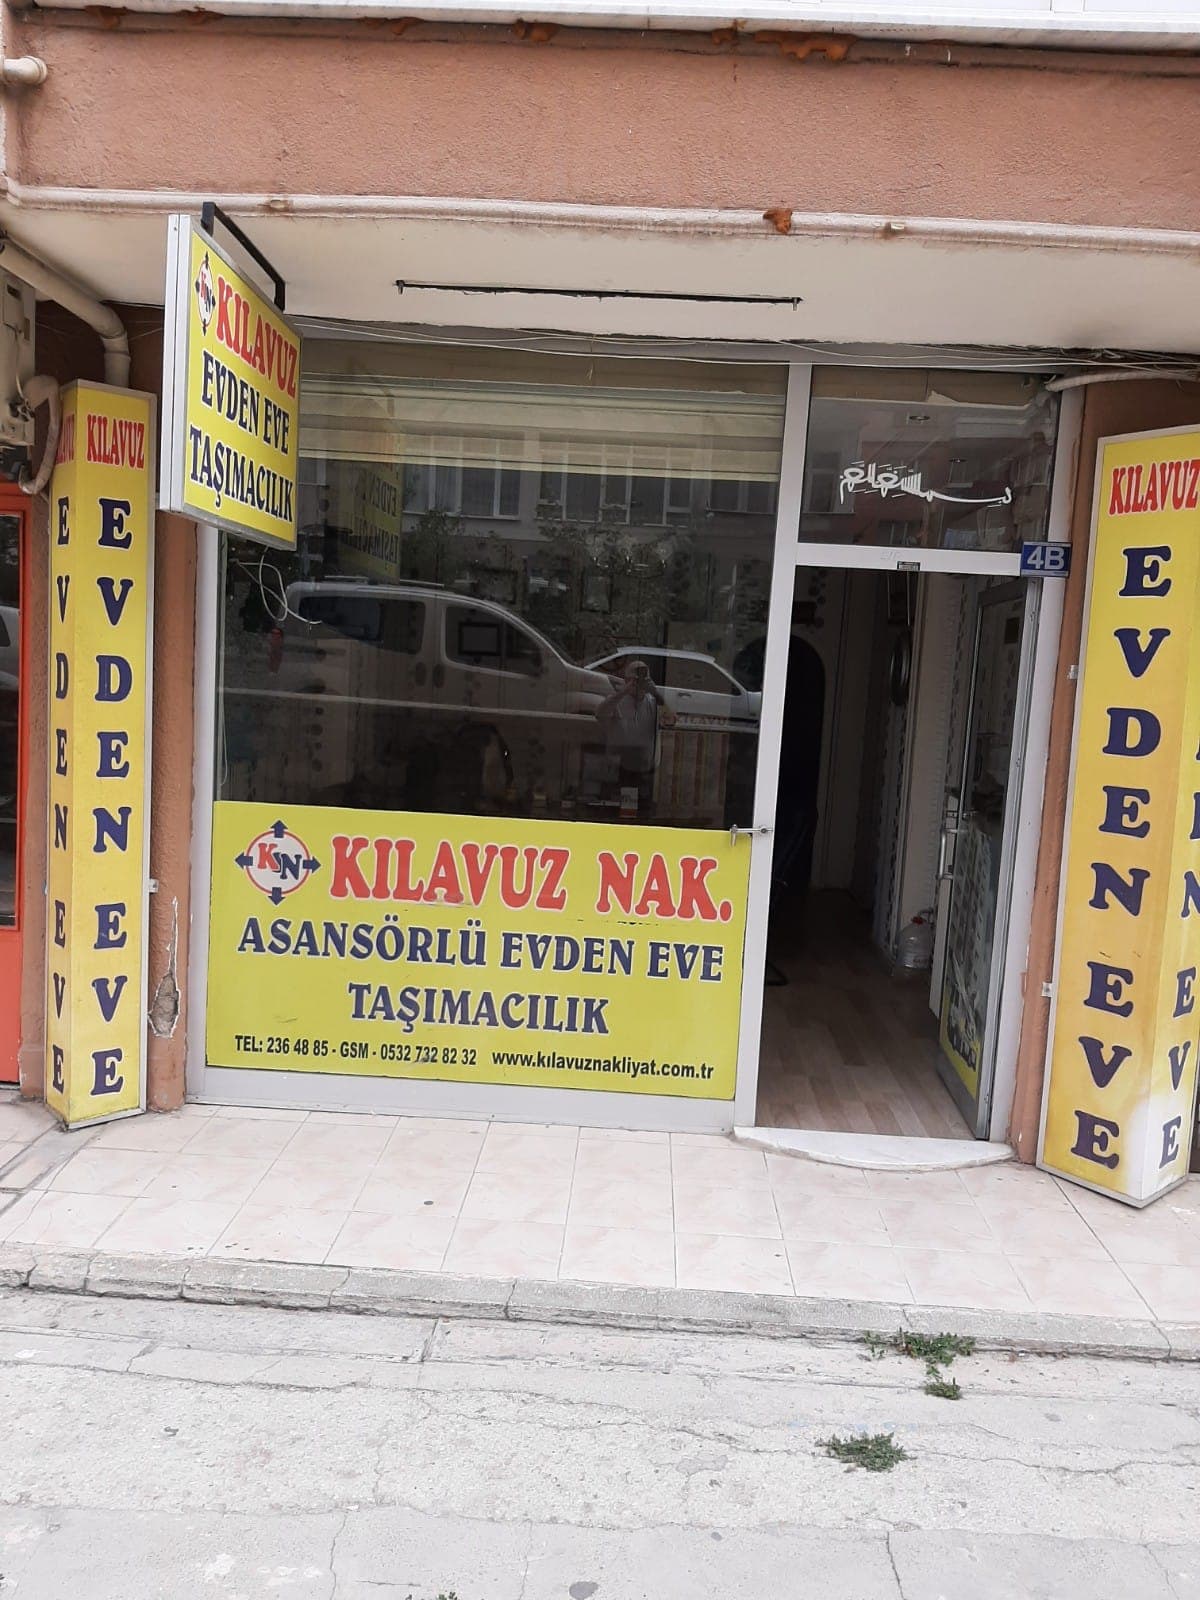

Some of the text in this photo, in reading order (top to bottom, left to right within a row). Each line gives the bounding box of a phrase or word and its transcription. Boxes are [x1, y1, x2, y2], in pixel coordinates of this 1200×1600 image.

[217, 276, 298, 399] KILAVUZ
[87, 414, 145, 469] KILAVUZ
[202, 350, 291, 455] EVDEN EVE
[190, 424, 293, 522] TAŞIMACILIK
[1026, 546, 1066, 571] 4B
[93, 497, 134, 853] EVDEN
[1089, 545, 1173, 917] EVDEN
[330, 835, 733, 922] KILAVUZ NAK.
[237, 914, 724, 982] ASANSÖRLÜ EVDEN EVE
[348, 982, 609, 1034] TAŞIMACILIK
[235, 1035, 263, 1053] TEL:
[267, 1037, 290, 1055] 236
[293, 1038, 309, 1056] 48
[313, 1039, 329, 1056] 85
[340, 1041, 369, 1059] GSM
[380, 1043, 411, 1062] 0532
[415, 1046, 438, 1063] 732
[442, 1047, 457, 1064] 82
[461, 1049, 477, 1065] 32
[492, 1050, 714, 1080] www.kılavuznakliyat.com.tr
